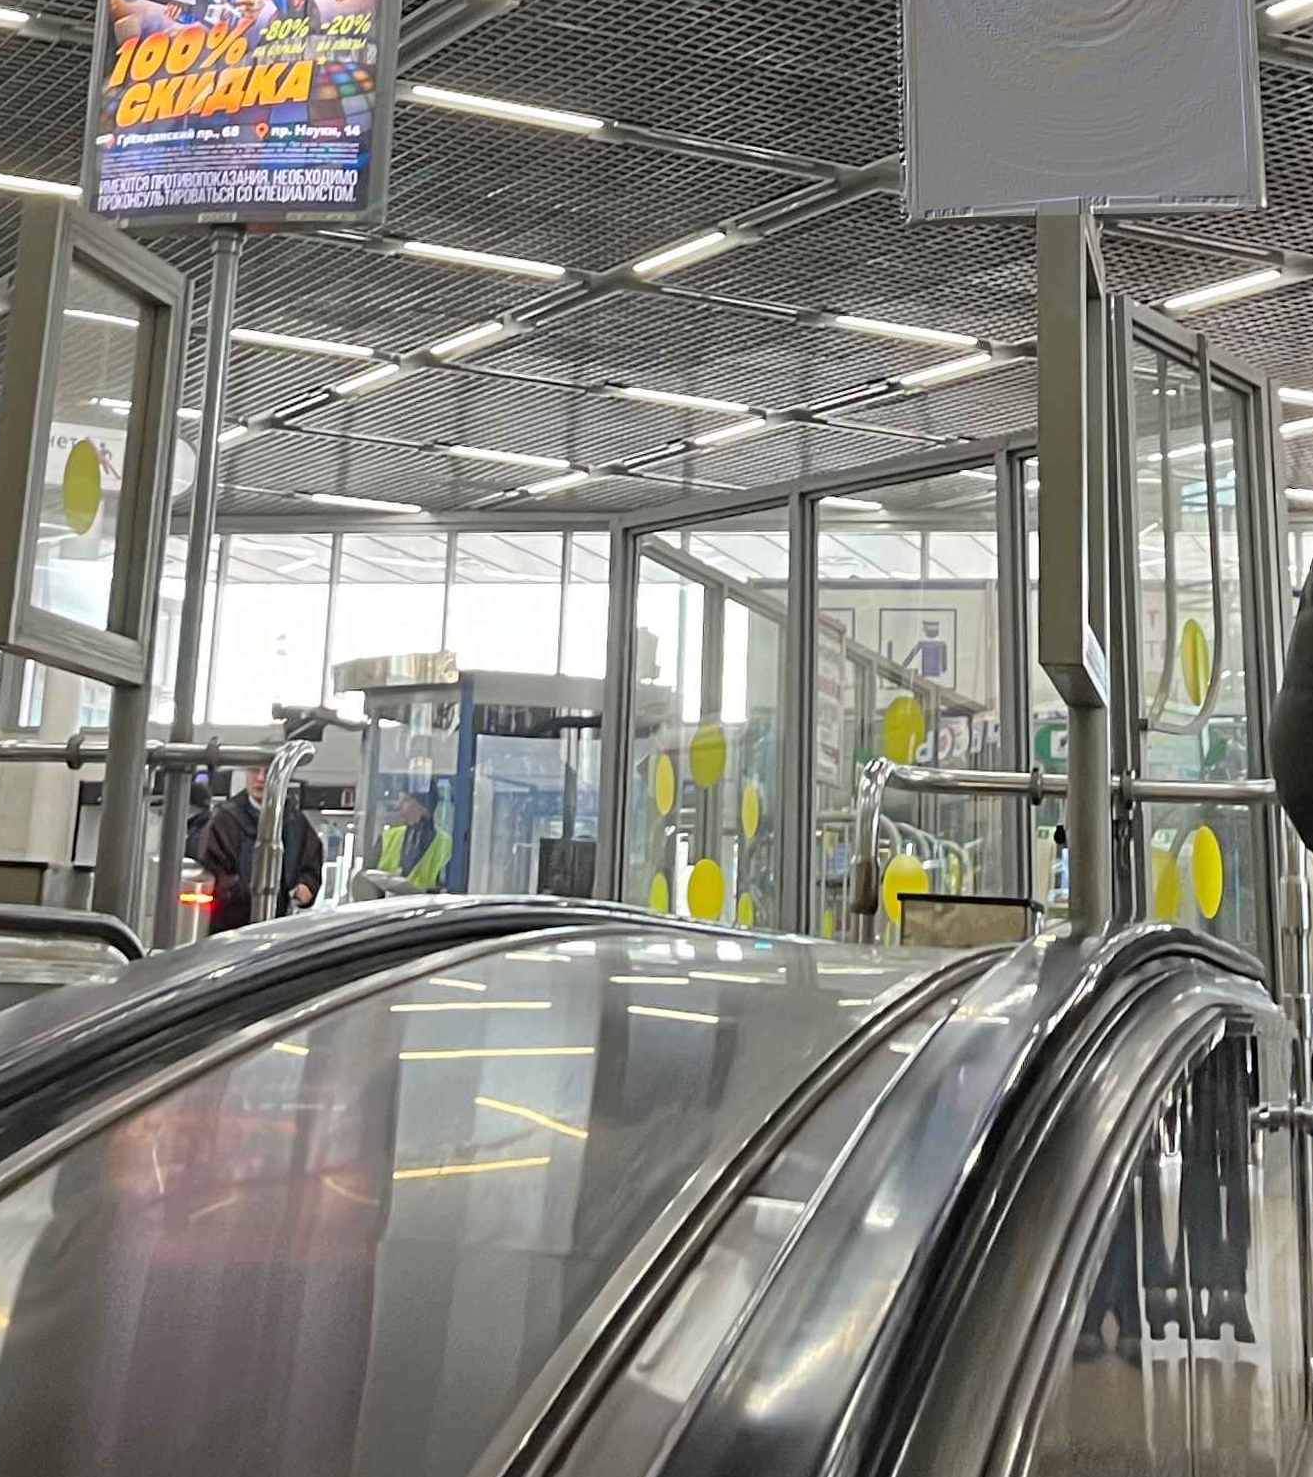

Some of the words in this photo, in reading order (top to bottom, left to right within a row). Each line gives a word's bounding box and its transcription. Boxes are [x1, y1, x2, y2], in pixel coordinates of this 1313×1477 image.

[259, 16, 310, 41] -80%
[321, 12, 372, 35] -20%
[110, 17, 256, 88] 100%
[272, 169, 358, 186] НЕОБХОДИМО
[236, 185, 253, 202] СО
